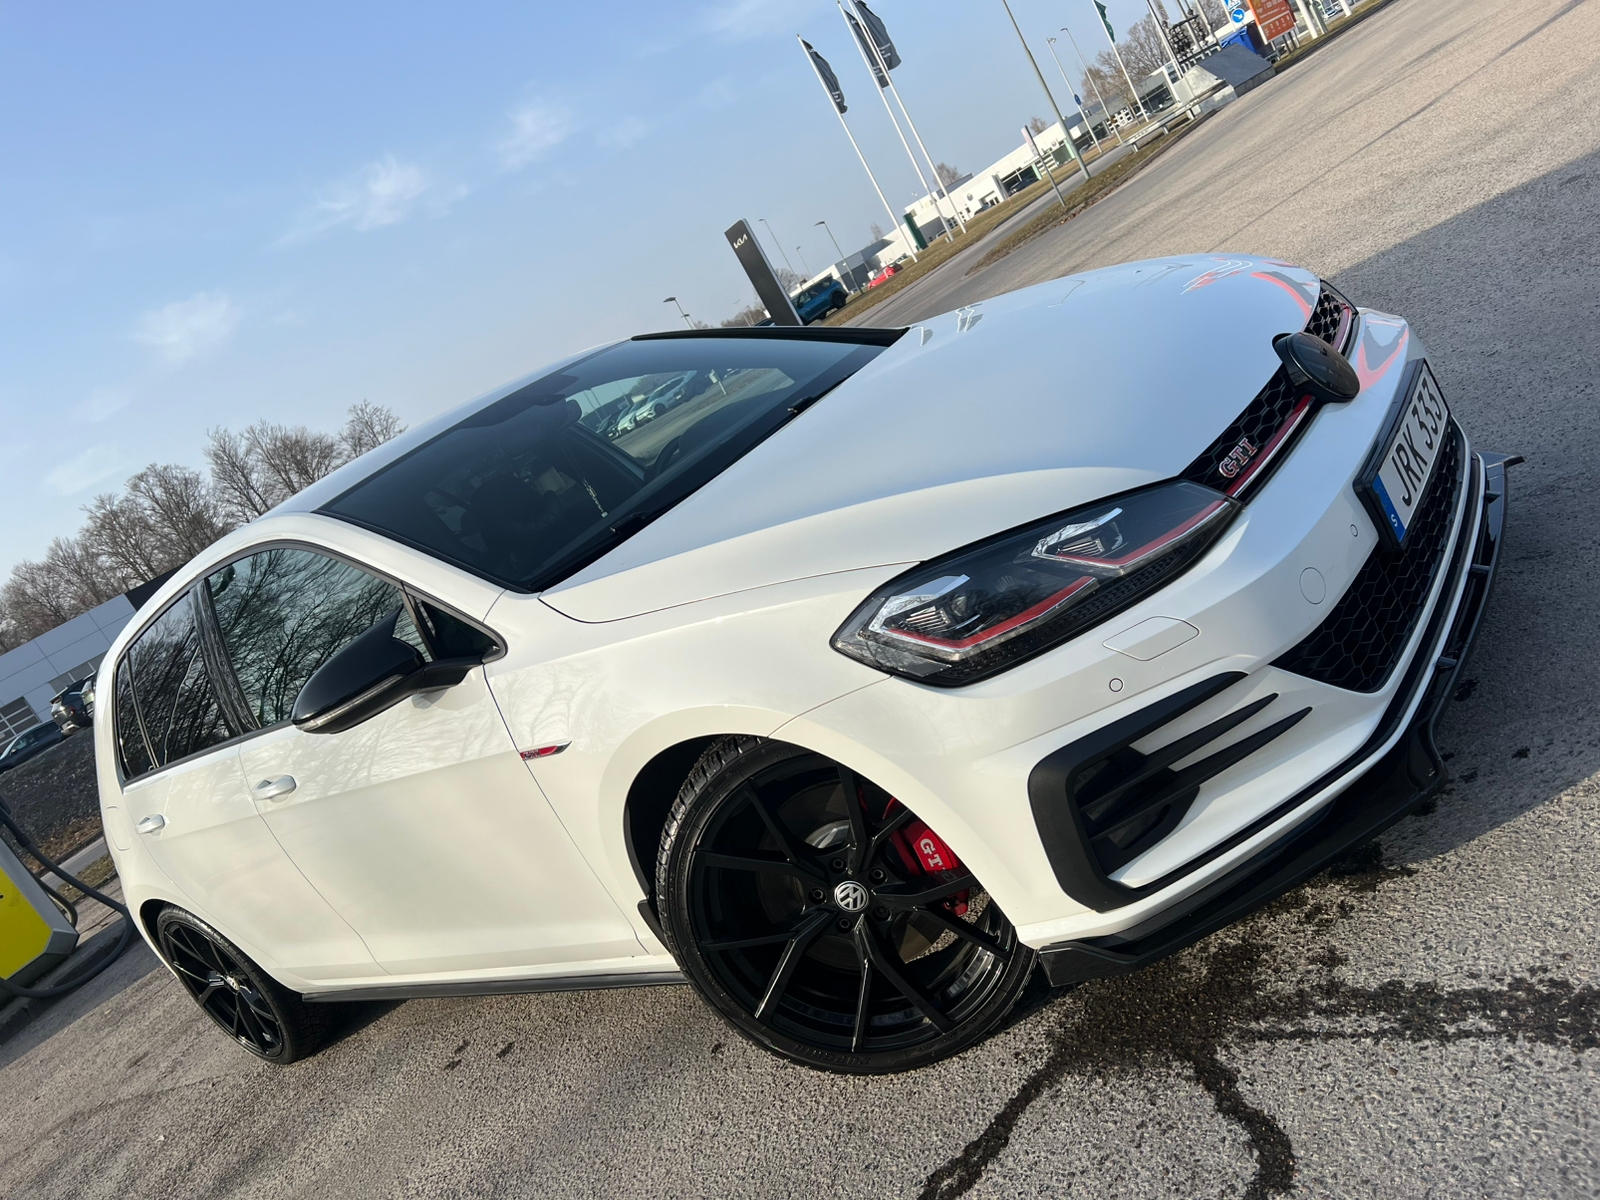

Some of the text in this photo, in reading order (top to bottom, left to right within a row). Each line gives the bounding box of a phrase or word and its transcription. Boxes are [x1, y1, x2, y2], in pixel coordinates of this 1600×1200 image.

[1219, 437, 1258, 478] GTI
[1391, 376, 1443, 507] JRK 333
[1390, 513, 1398, 528] S
[920, 838, 946, 870] GT
